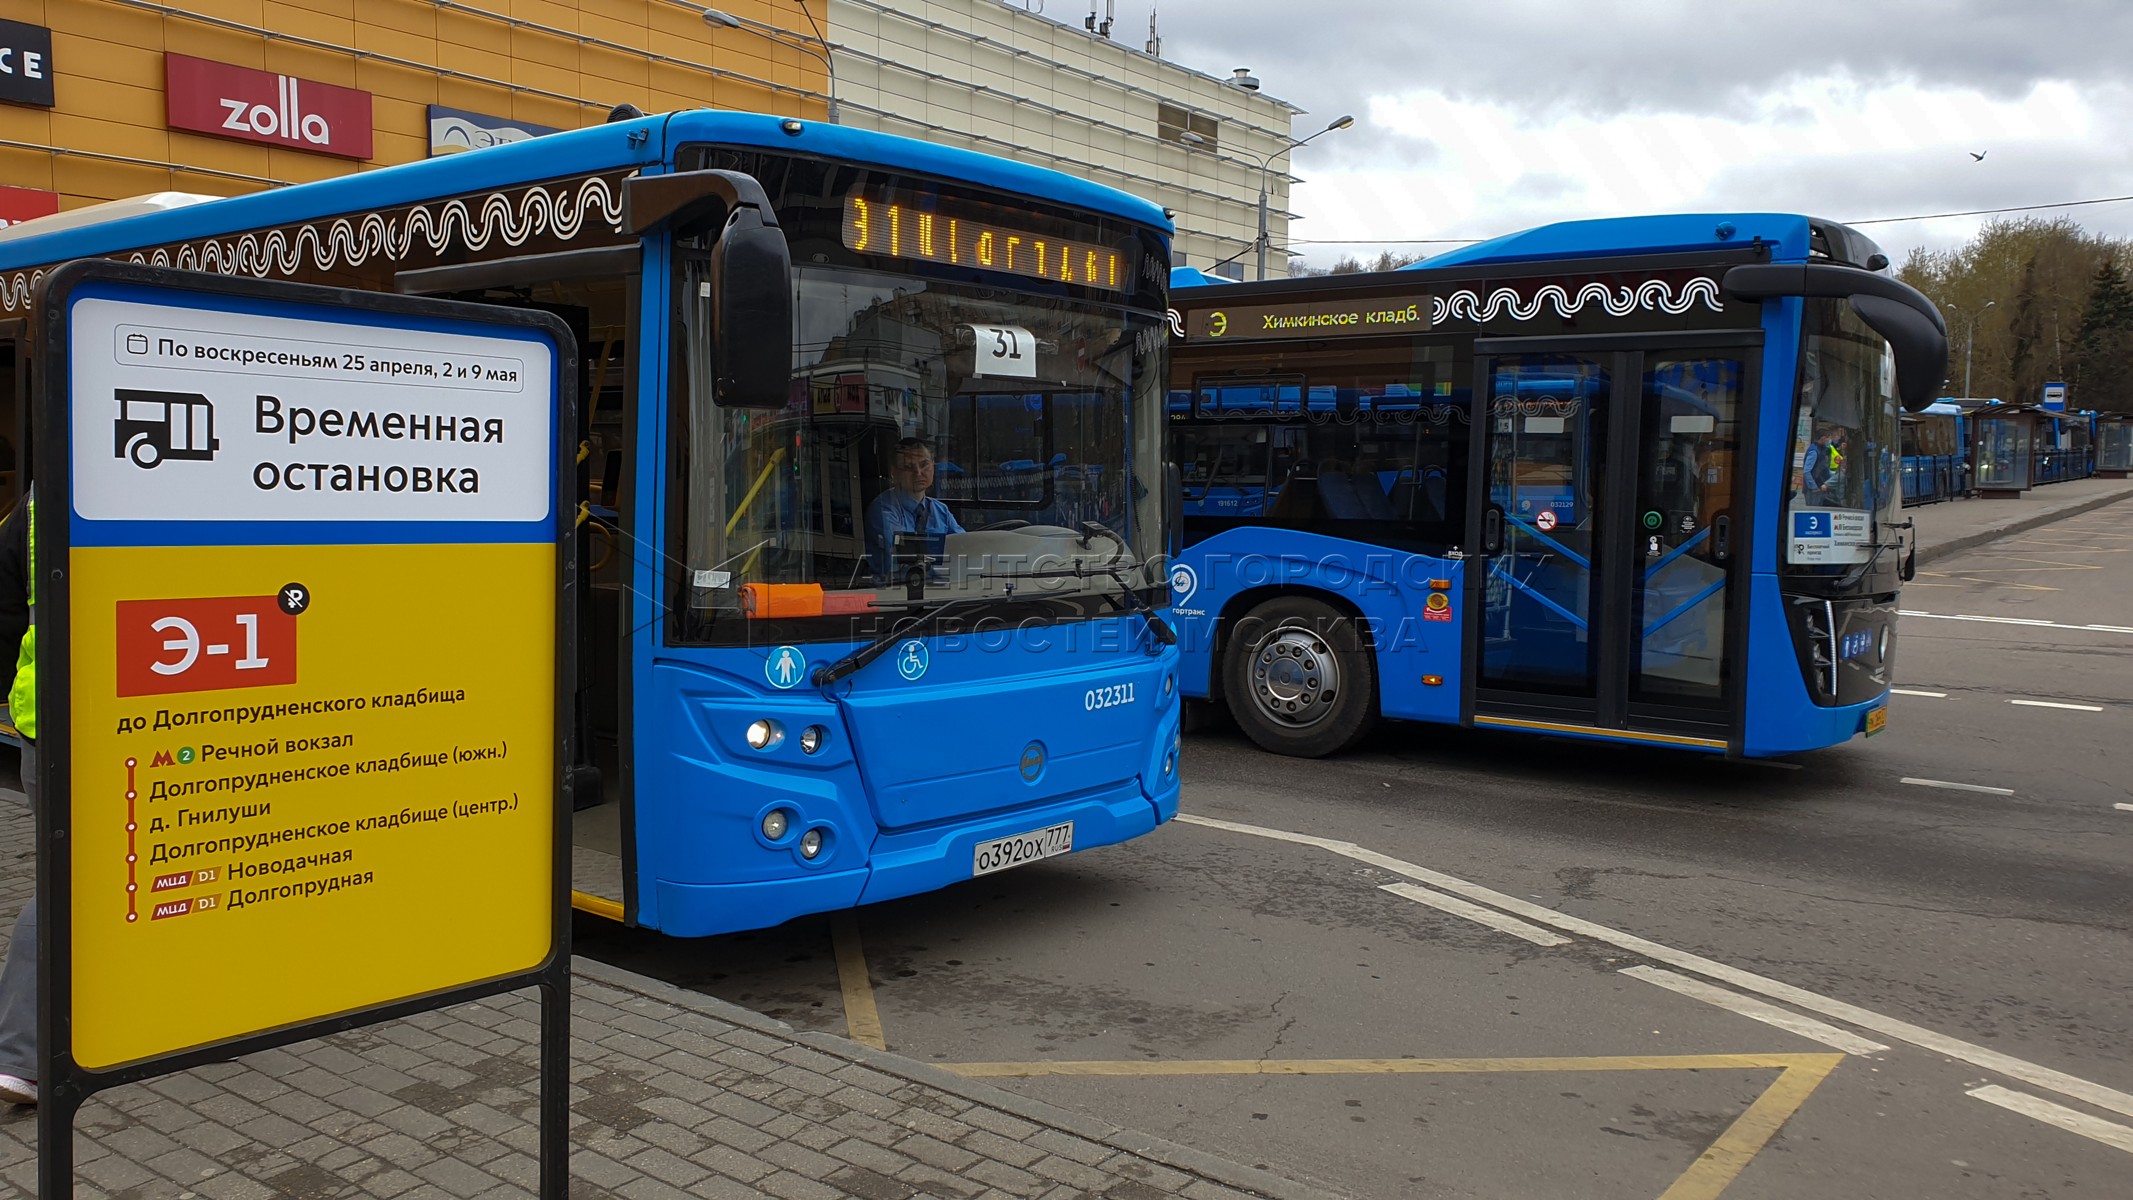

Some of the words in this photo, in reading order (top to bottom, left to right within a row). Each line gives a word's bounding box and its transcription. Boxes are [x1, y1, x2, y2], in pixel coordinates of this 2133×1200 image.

[220, 75, 329, 145] zolla
[1209, 311, 1227, 337] Э
[1262, 311, 1358, 330] Химкинское
[1366, 304, 1420, 324] кладб.
[989, 328, 1021, 359] 31
[158, 339, 188, 357] По
[194, 345, 338, 369] воскресеньям
[343, 354, 365, 371] 25
[369, 360, 438, 379] апреля,
[443, 362, 452, 377] 2
[458, 367, 467, 379] и
[471, 365, 482, 380] 9
[486, 369, 518, 383] мая
[254, 394, 503, 444] Временная
[253, 461, 480, 494] остановка
[1809, 516, 1818, 530] Э
[150, 613, 270, 676] Э-1
[116, 716, 146, 735] до
[152, 698, 366, 732] Долгопрудненского
[372, 688, 466, 708] кладбища
[1085, 682, 1135, 711] 032311
[202, 738, 279, 762] Речной
[285, 734, 353, 753] вокзал
[150, 763, 350, 803] Долгопрудненское
[355, 752, 448, 773] кладбище
[453, 741, 507, 764] (южн.)
[149, 817, 170, 834] д.
[178, 802, 271, 827] Гнилуши
[150, 821, 350, 865] Долгопрудненское
[356, 808, 448, 832] кладбище
[453, 793, 518, 819] (центр.)
[1047, 825, 1069, 847] 777
[228, 850, 353, 881] Новодачная
[227, 872, 374, 911] Долгопрудная
